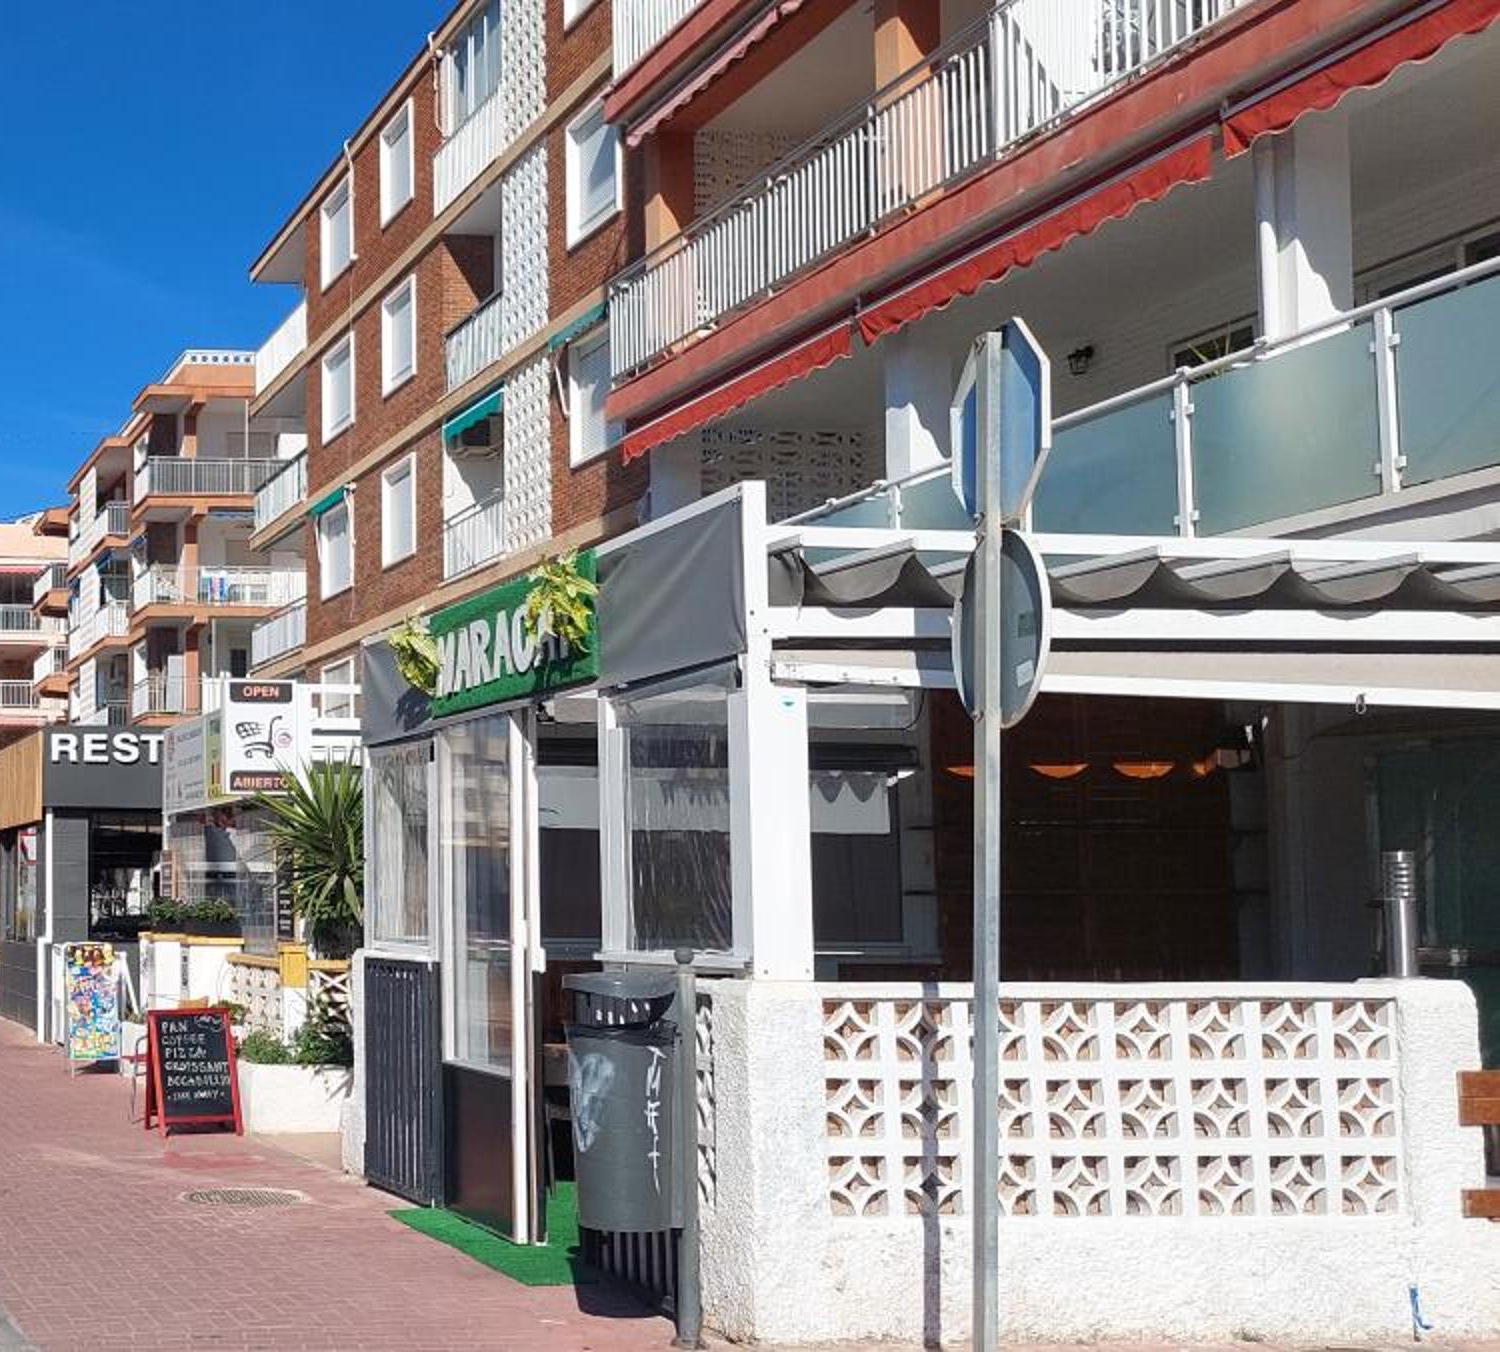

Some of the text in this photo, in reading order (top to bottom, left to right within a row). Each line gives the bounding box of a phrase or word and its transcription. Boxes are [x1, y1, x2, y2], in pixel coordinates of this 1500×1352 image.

[243, 686, 279, 697] OPEN
[51, 733, 164, 763] REST
[233, 777, 290, 789] ABIERTO
[162, 1021, 188, 1033] PAN
